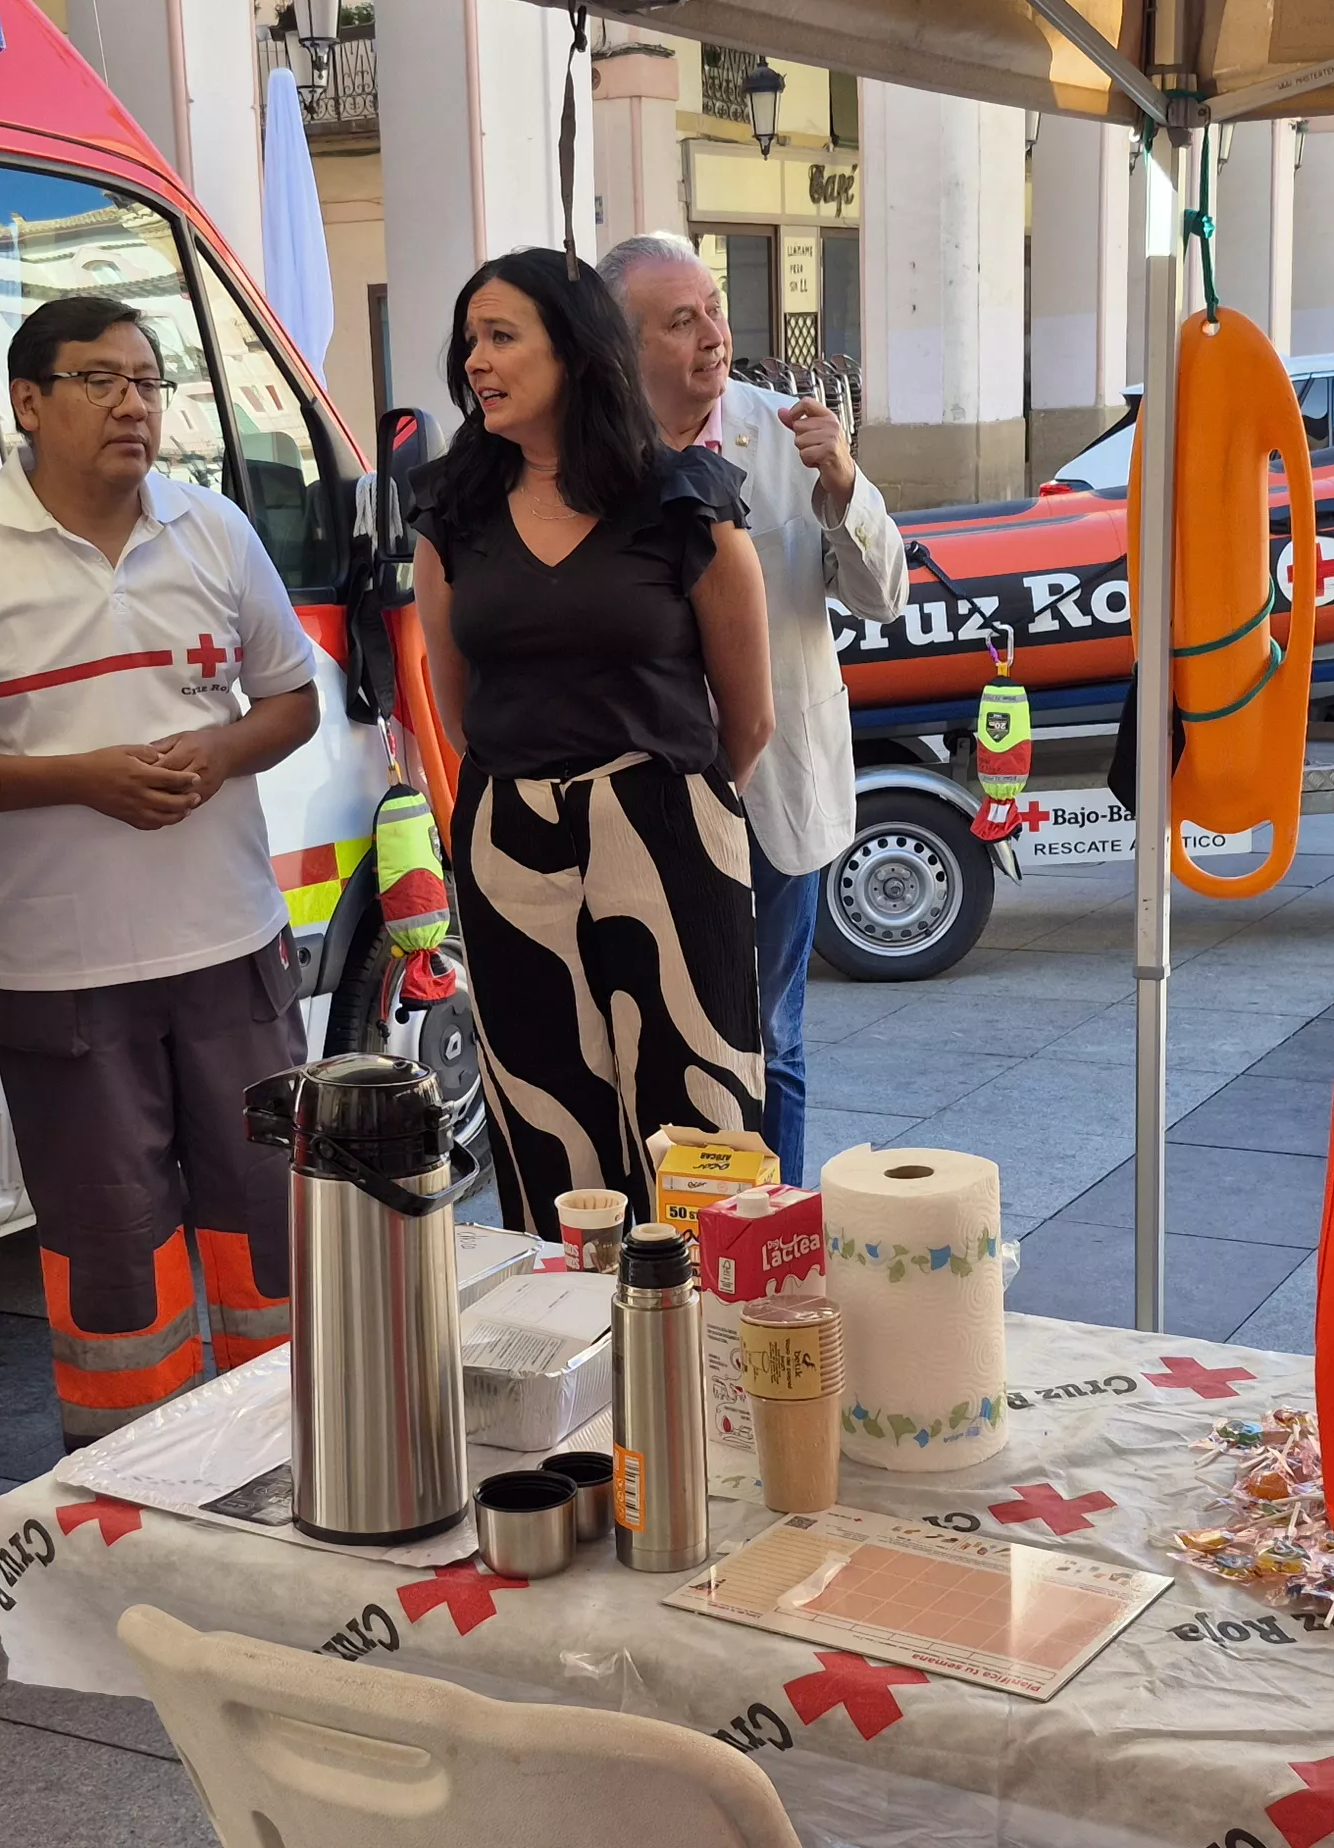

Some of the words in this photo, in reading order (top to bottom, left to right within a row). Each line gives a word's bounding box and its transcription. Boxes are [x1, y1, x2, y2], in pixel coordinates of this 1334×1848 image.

[808, 164, 859, 218] Café
[825, 595, 1003, 653] Cruz
[1023, 572, 1131, 634] Ro
[1034, 839, 1123, 856] RESCATE
[669, 1206, 687, 1219] 50
[1034, 1375, 1138, 1400] Cruz
[922, 1512, 981, 1533] Cr
[321, 1603, 400, 1662] Cruz
[1166, 1612, 1299, 1649] Roja
[911, 1653, 964, 1670] semana
[965, 1666, 979, 1675] tu
[982, 1670, 1042, 1693] Planifica
[710, 1702, 794, 1754] Cru
